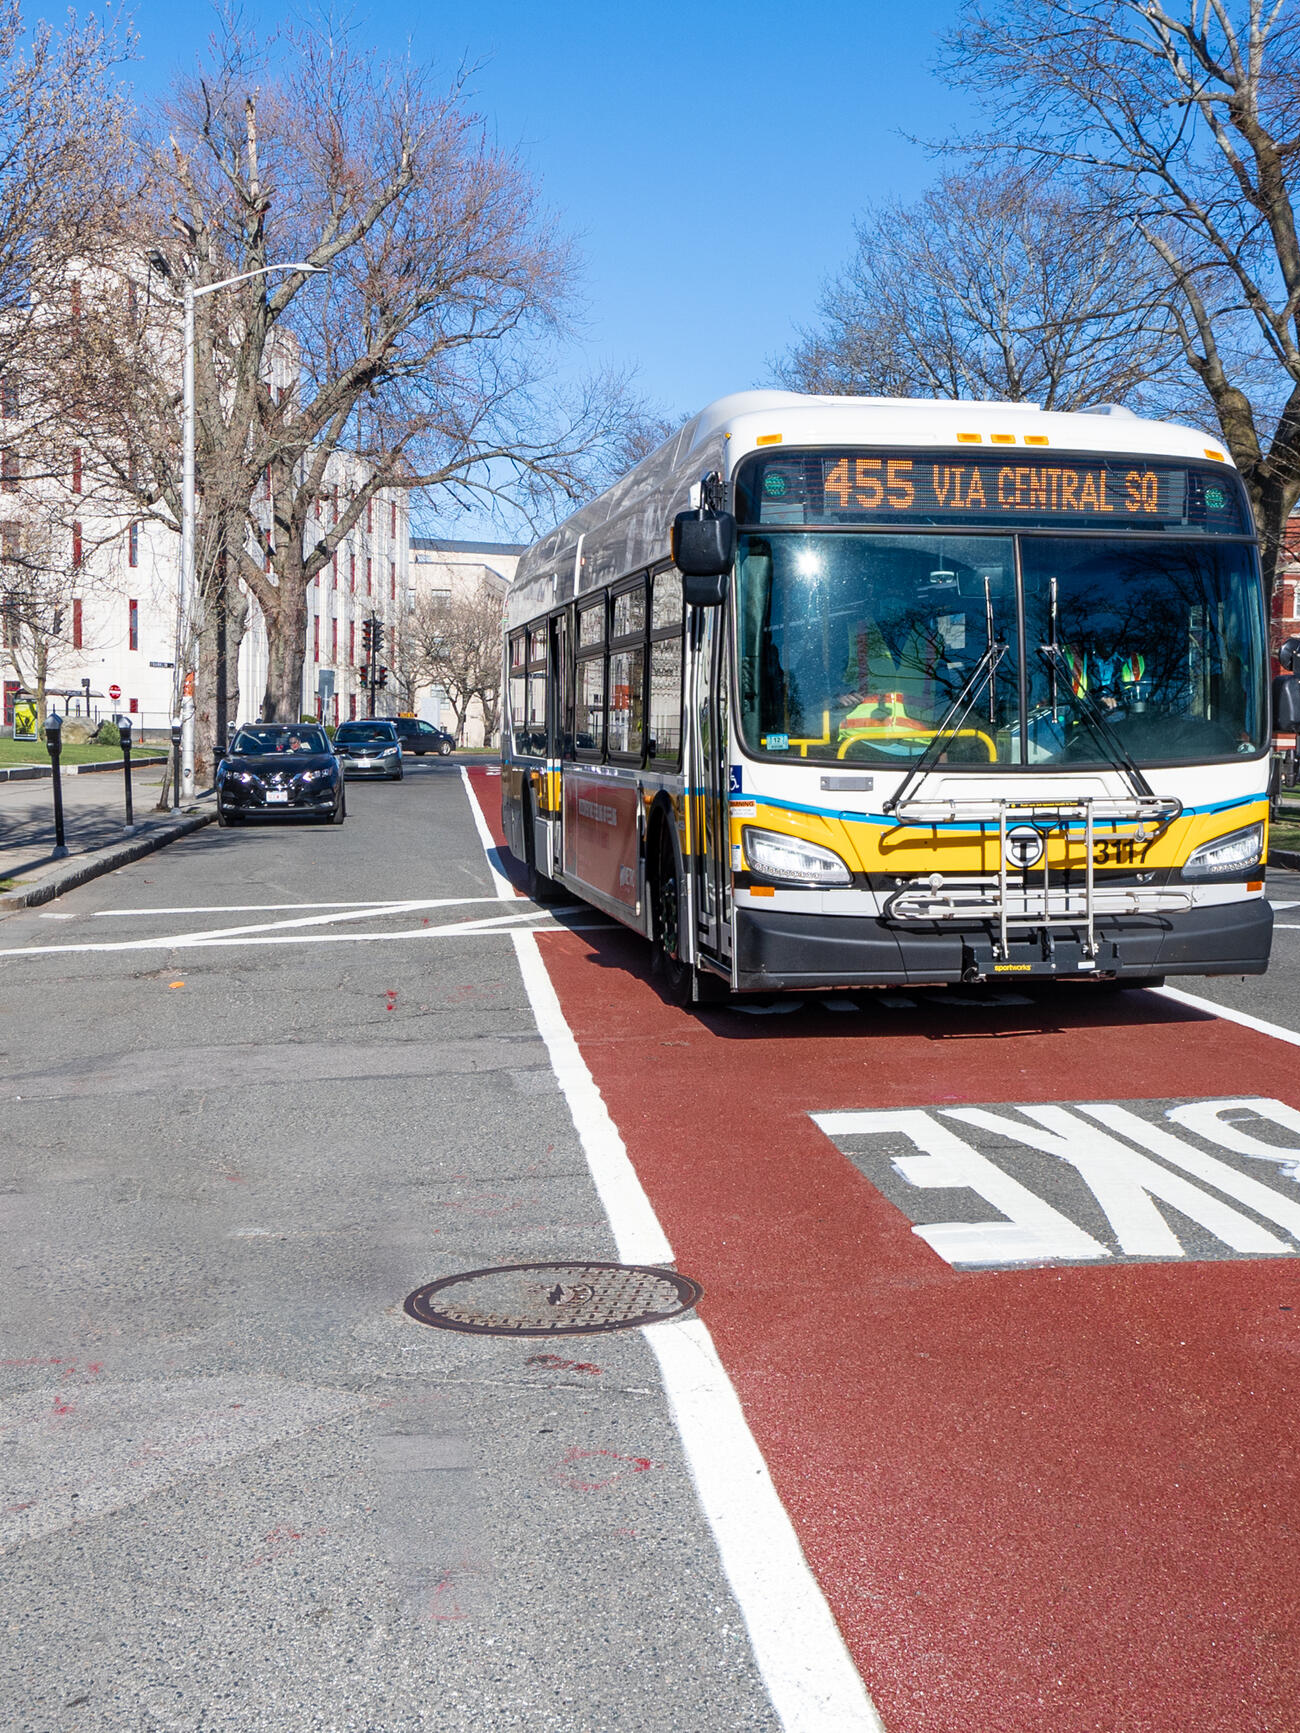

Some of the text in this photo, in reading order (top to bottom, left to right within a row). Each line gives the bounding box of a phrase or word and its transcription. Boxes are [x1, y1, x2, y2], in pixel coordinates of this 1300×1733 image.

[824, 458, 1158, 512] 455 VIA CENTRAL SQ
[1009, 833, 1039, 863] T
[1093, 839, 1153, 865] 3117
[994, 963, 1032, 972] sportworks
